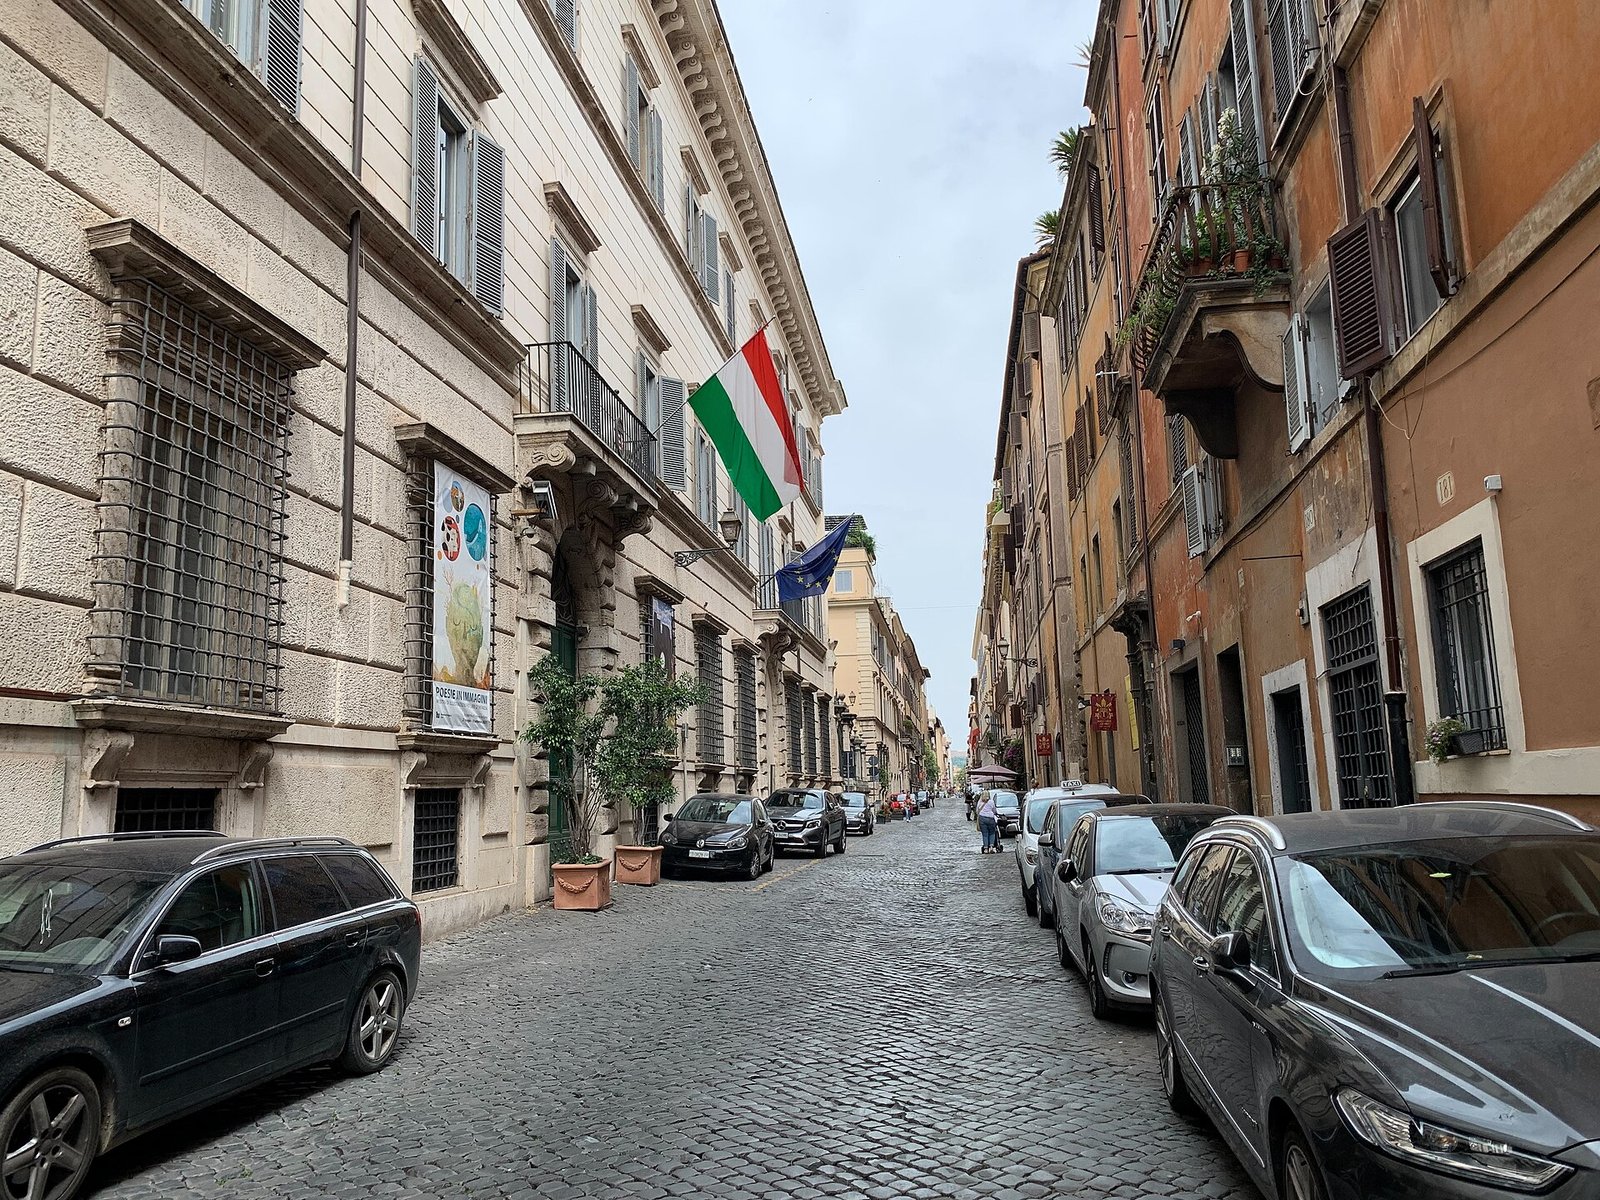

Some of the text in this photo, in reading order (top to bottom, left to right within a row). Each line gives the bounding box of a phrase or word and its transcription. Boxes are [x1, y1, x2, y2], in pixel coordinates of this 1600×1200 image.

[1439, 475, 1453, 502] 181
[436, 686, 488, 704] POESIE IN IMMAGINI
